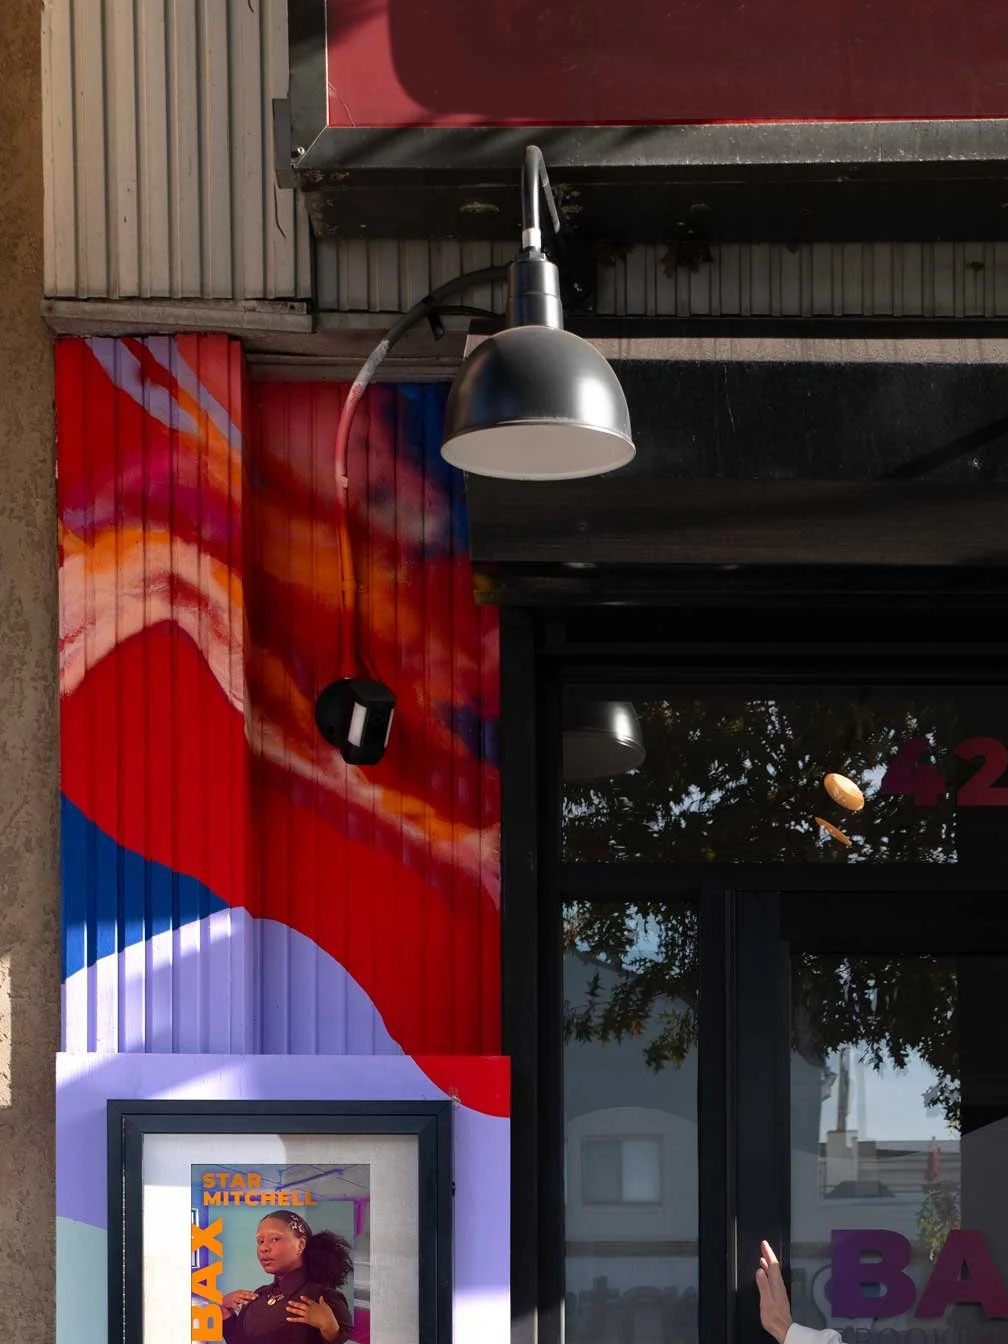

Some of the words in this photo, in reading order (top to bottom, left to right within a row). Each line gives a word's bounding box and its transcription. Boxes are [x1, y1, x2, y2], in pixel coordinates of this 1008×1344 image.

[203, 1173, 262, 1189] STAR
[203, 1191, 316, 1207] MITCHELL
[191, 1217, 223, 1342] BAX
